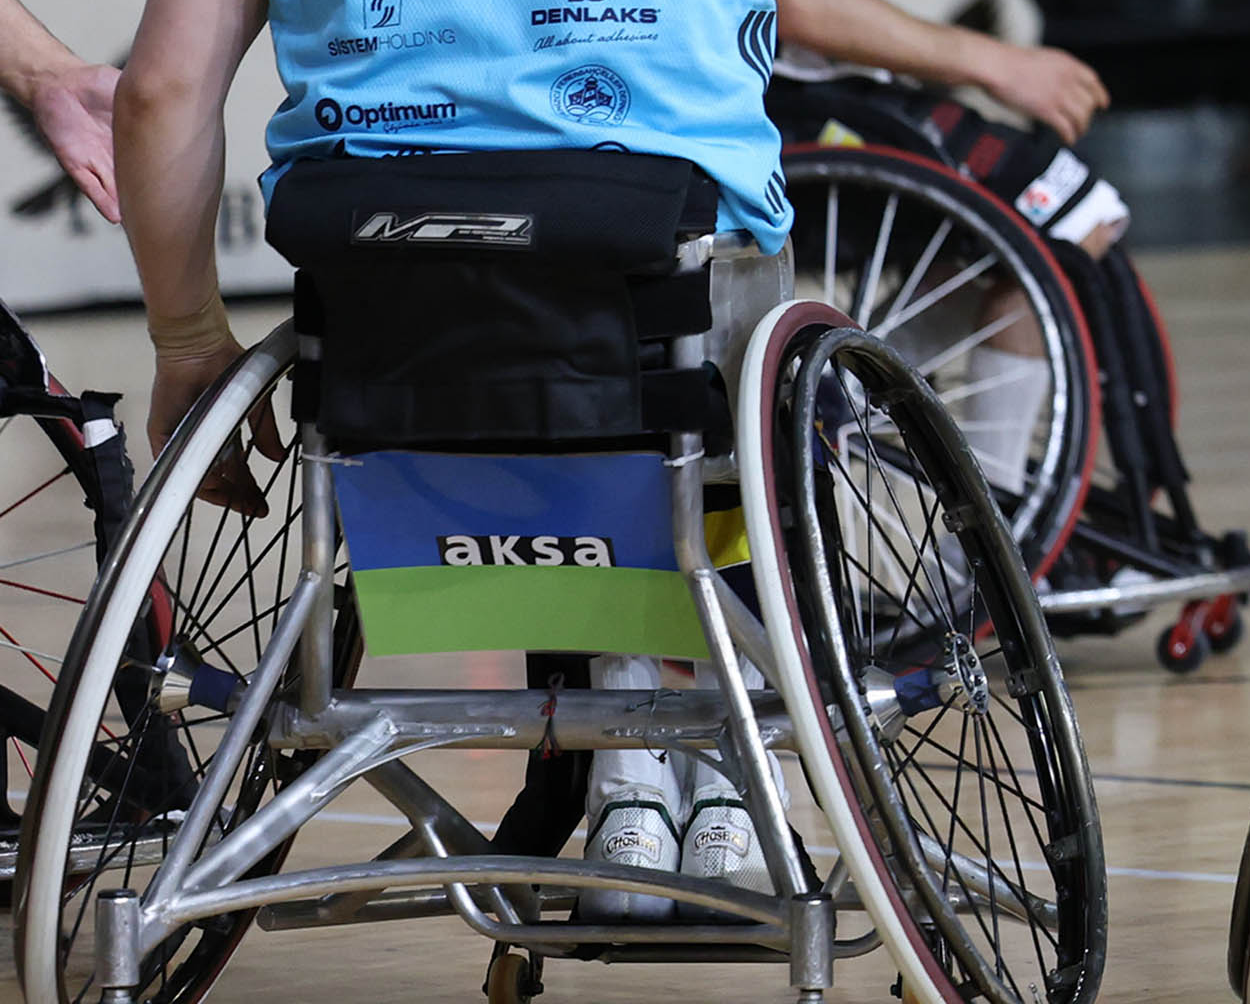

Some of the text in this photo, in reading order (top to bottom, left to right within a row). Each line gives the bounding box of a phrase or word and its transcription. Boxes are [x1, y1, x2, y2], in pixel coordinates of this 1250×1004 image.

[530, 6, 660, 27] DENLAKS
[533, 34, 555, 53] All
[555, 31, 594, 47] about
[345, 101, 457, 130] Optimum
[444, 534, 612, 568] aksa
